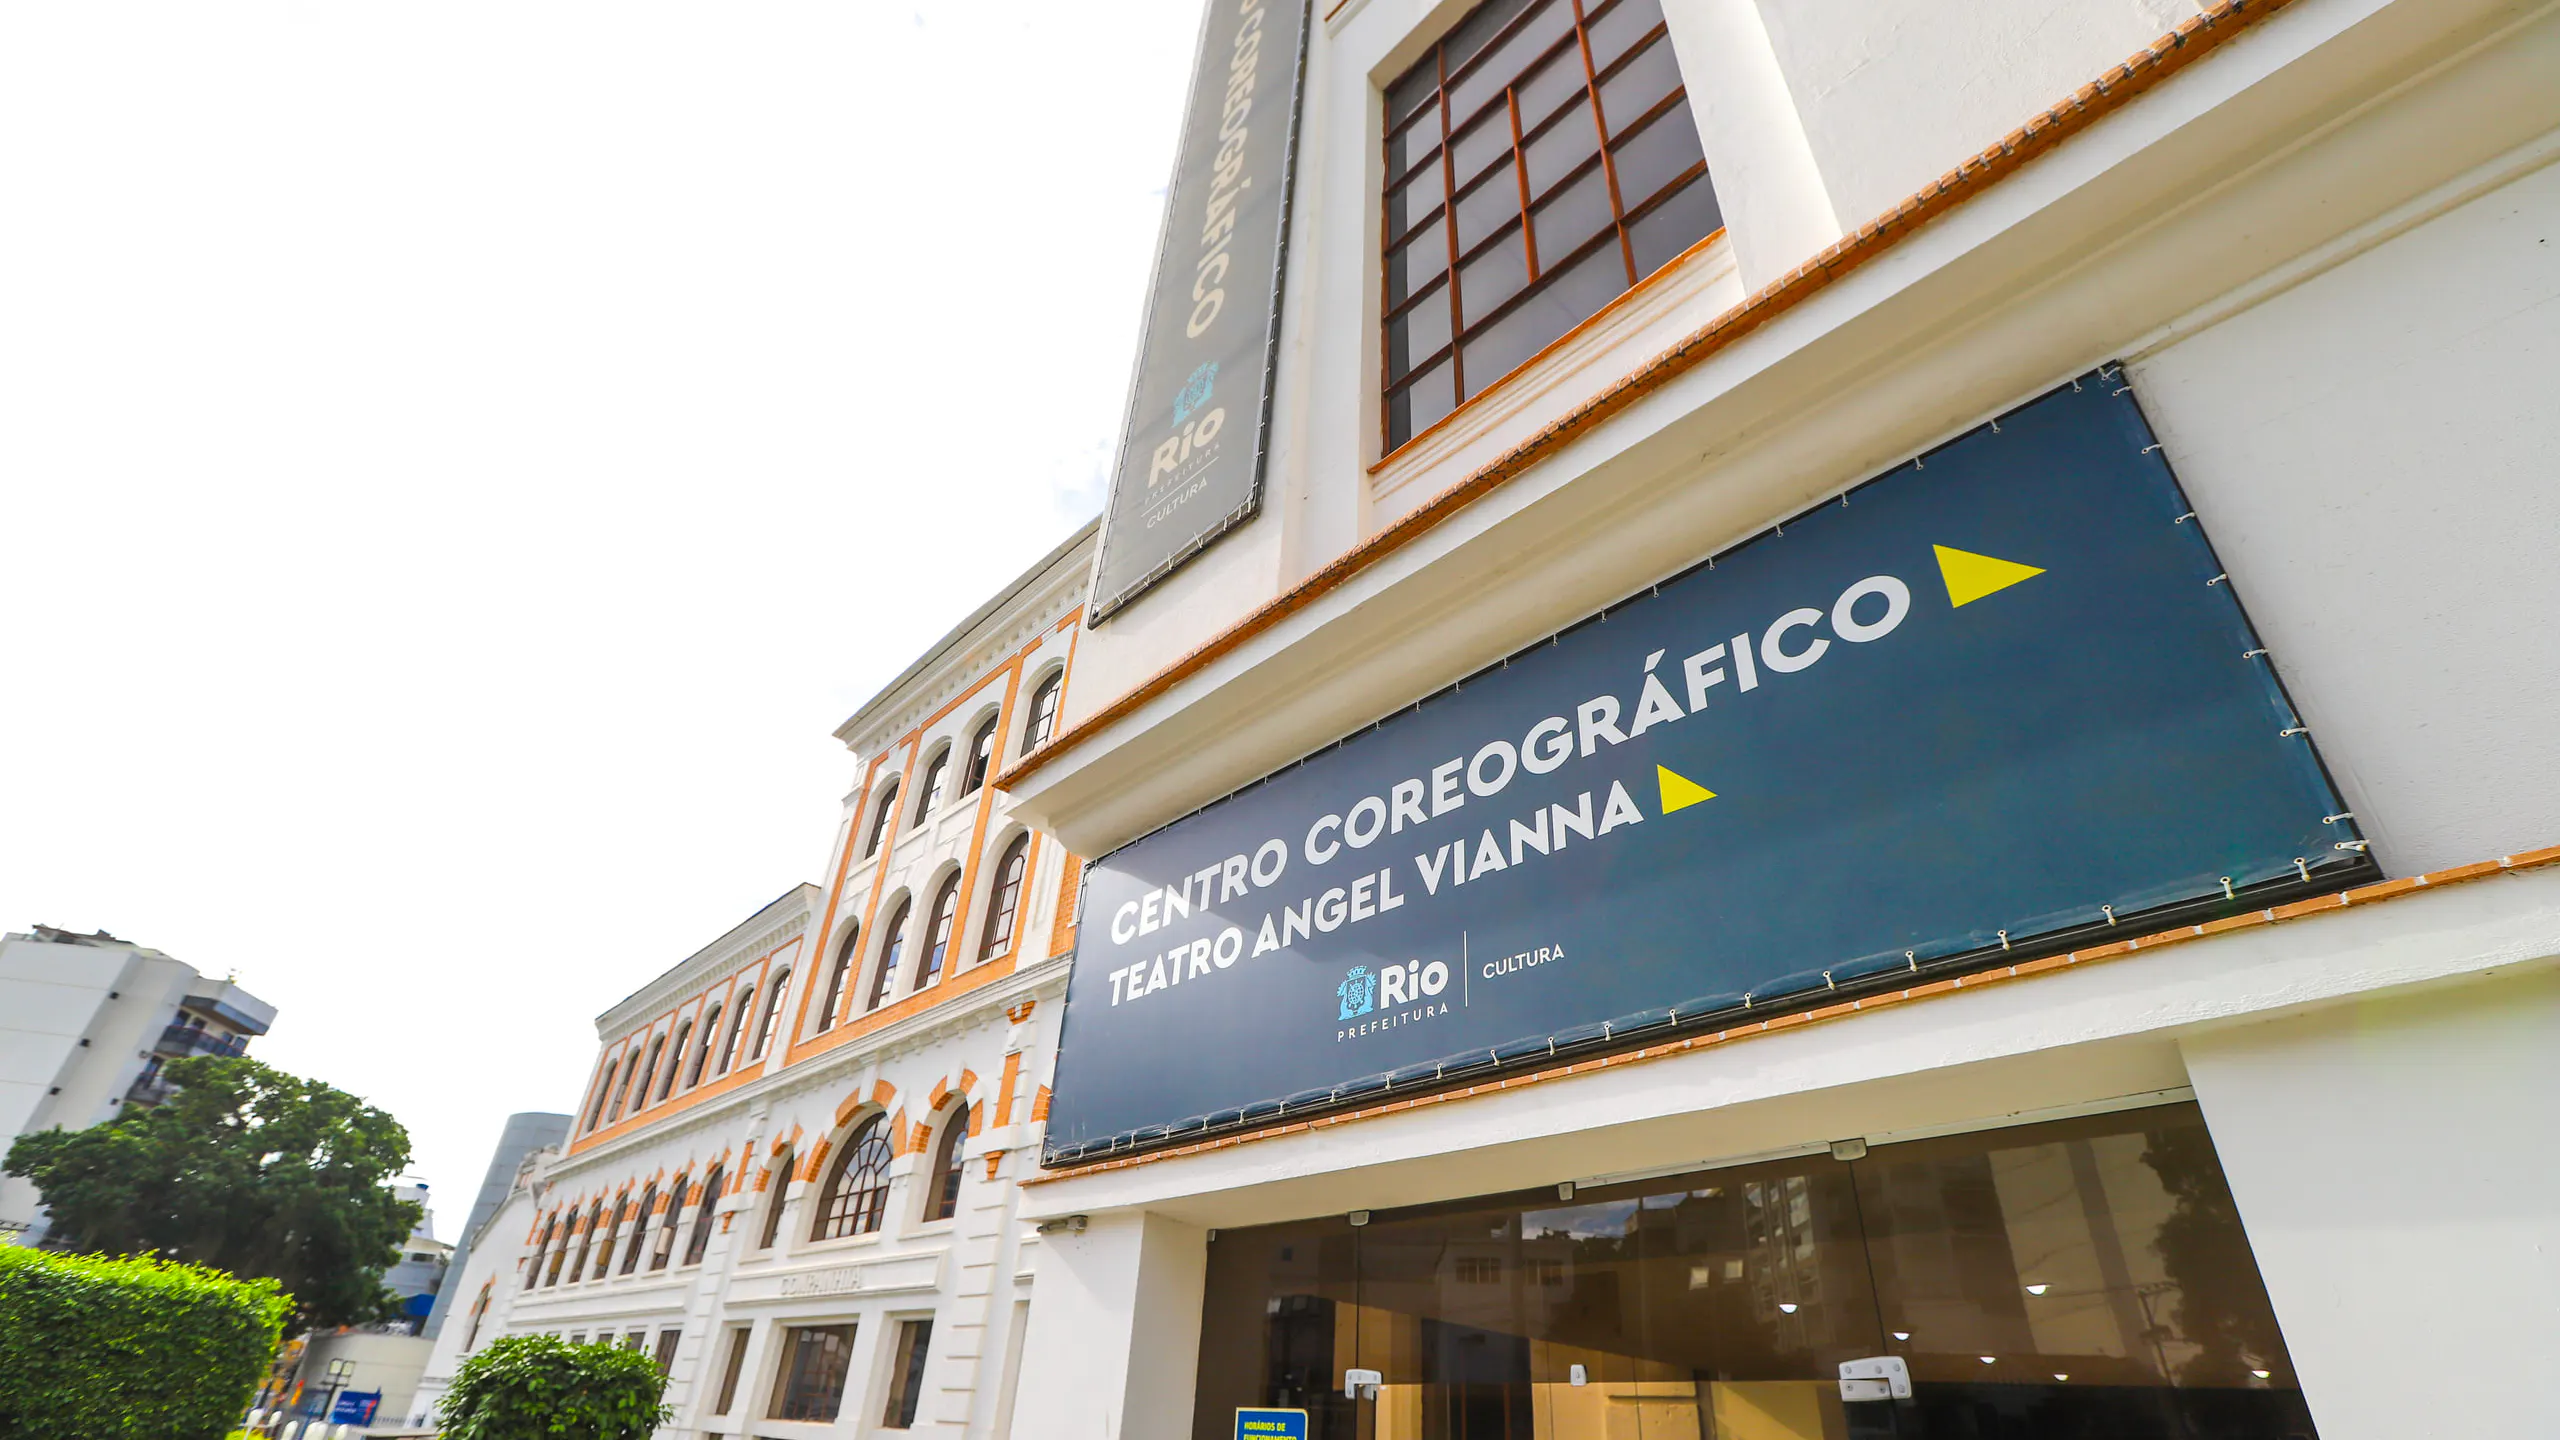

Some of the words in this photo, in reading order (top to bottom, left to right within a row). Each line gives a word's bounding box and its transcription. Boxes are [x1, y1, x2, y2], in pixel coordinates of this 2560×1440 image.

[1186, 7, 1265, 339] COREOGRÁFICO
[1146, 479, 1208, 529] CULTURA
[1110, 838, 1288, 946] CENTRO
[1304, 575, 1911, 866] COREOGRÁFICO
[1108, 927, 1244, 1007] TEATRO
[1251, 867, 1405, 959] ANGEL
[1414, 780, 1645, 896] VIANNA
[1380, 959, 1449, 1010] Rio
[1482, 943, 1565, 979] CULTURA
[1337, 1002, 1449, 1042] PREFEITURA
[1276, 1422, 1286, 1432] DE
